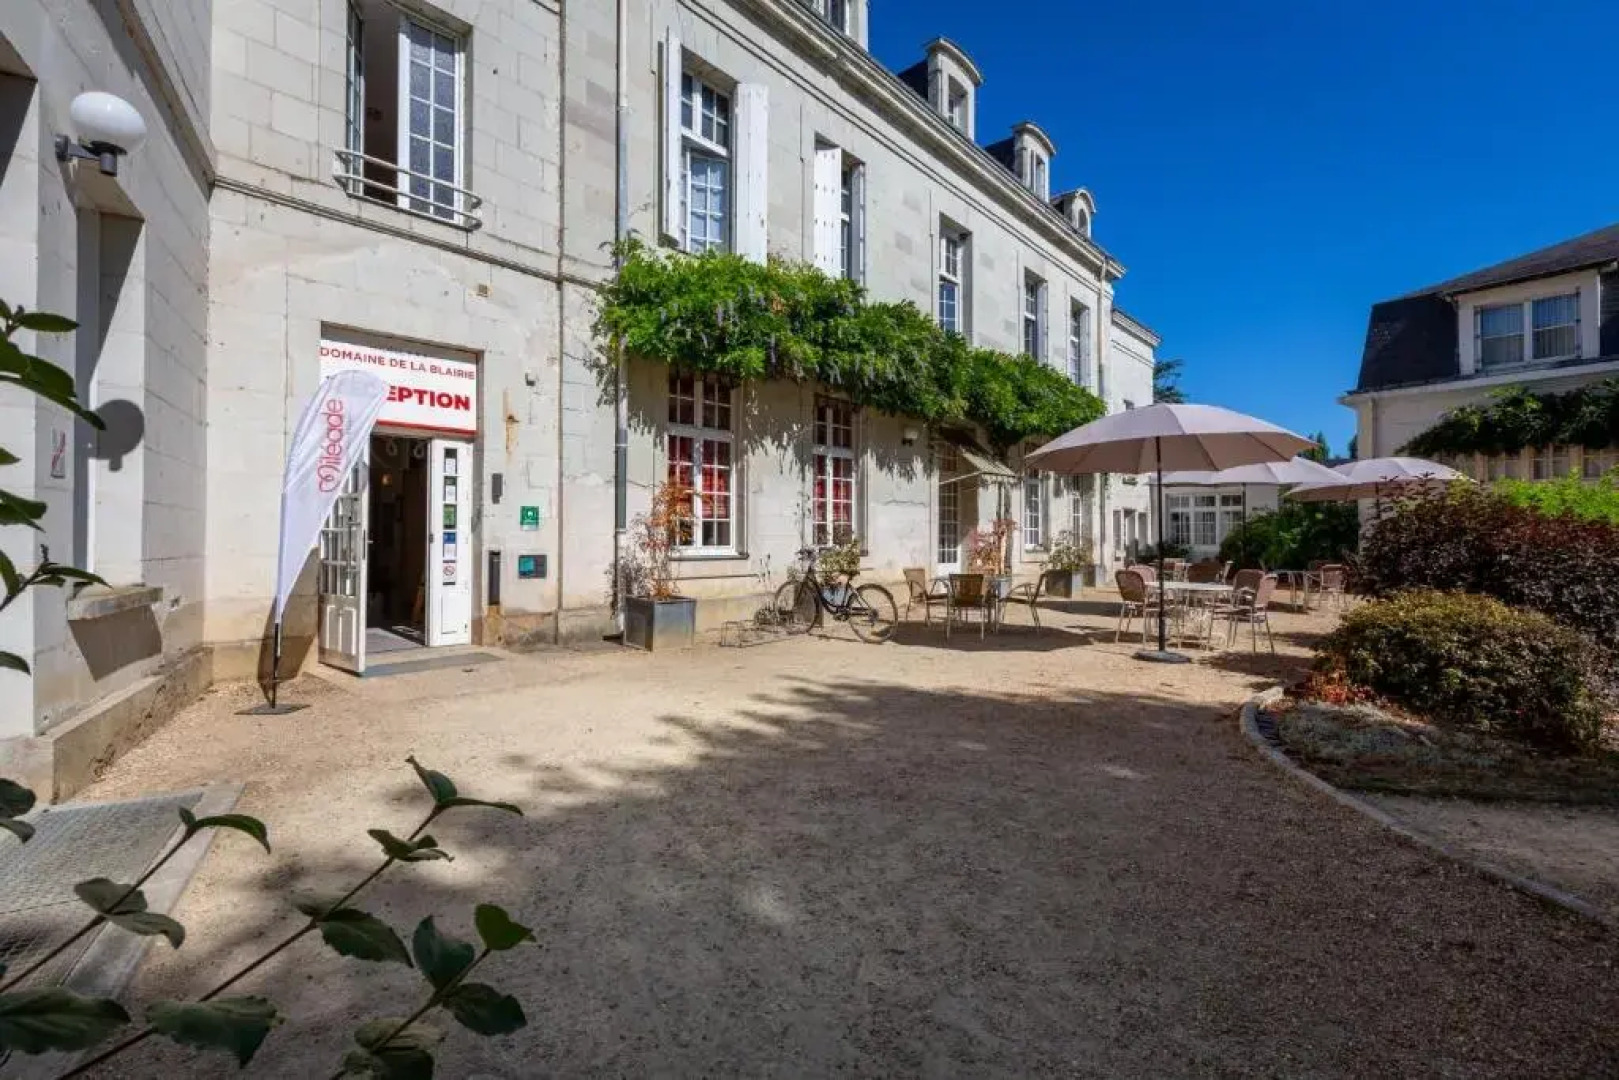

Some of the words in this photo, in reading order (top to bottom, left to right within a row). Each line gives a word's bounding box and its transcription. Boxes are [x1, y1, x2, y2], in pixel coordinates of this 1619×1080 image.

[320, 347, 385, 366] DOMAINE
[390, 357, 407, 369] DE
[410, 361, 426, 373] LA
[429, 364, 475, 380] BLAIRIE
